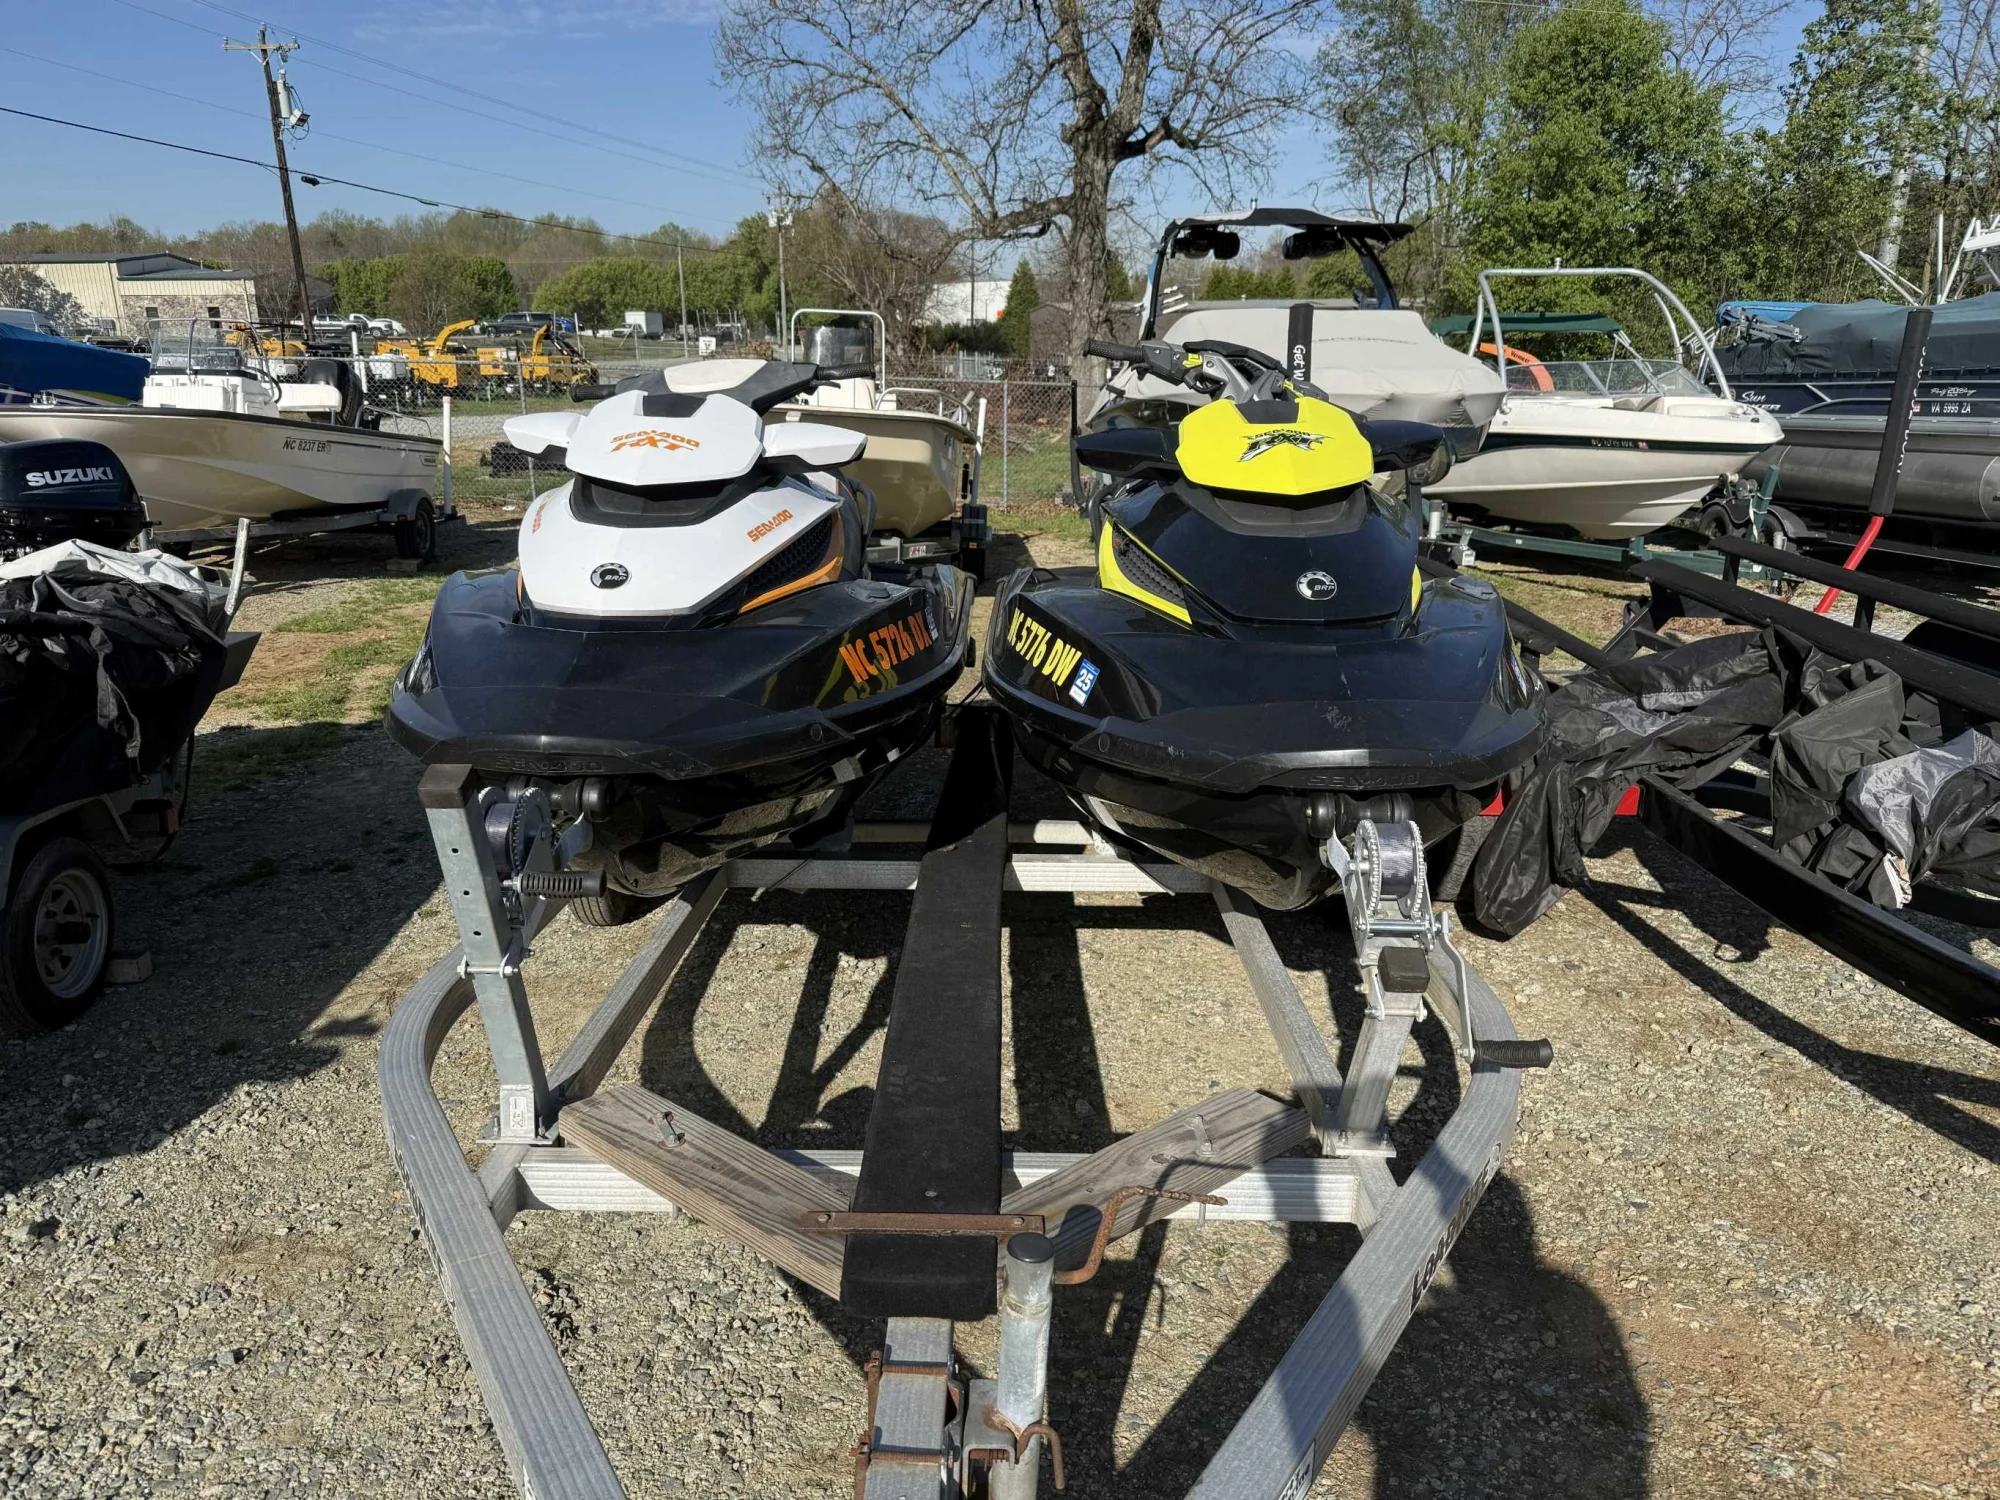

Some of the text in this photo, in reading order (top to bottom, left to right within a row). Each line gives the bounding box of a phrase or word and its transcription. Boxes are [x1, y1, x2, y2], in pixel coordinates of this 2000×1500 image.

[1293, 344, 1306, 381] Get W
[1738, 390, 1767, 403] Sun
[1931, 402, 1941, 414] VA
[1961, 402, 1971, 414] ZA
[282, 438, 326, 453] NC 8237 ER
[26, 466, 114, 487] SUZUKI
[839, 638, 879, 684] NC
[867, 619, 916, 671] 5726
[1007, 607, 1083, 687] NC 5776 DW
[1075, 668, 1094, 692] 25
